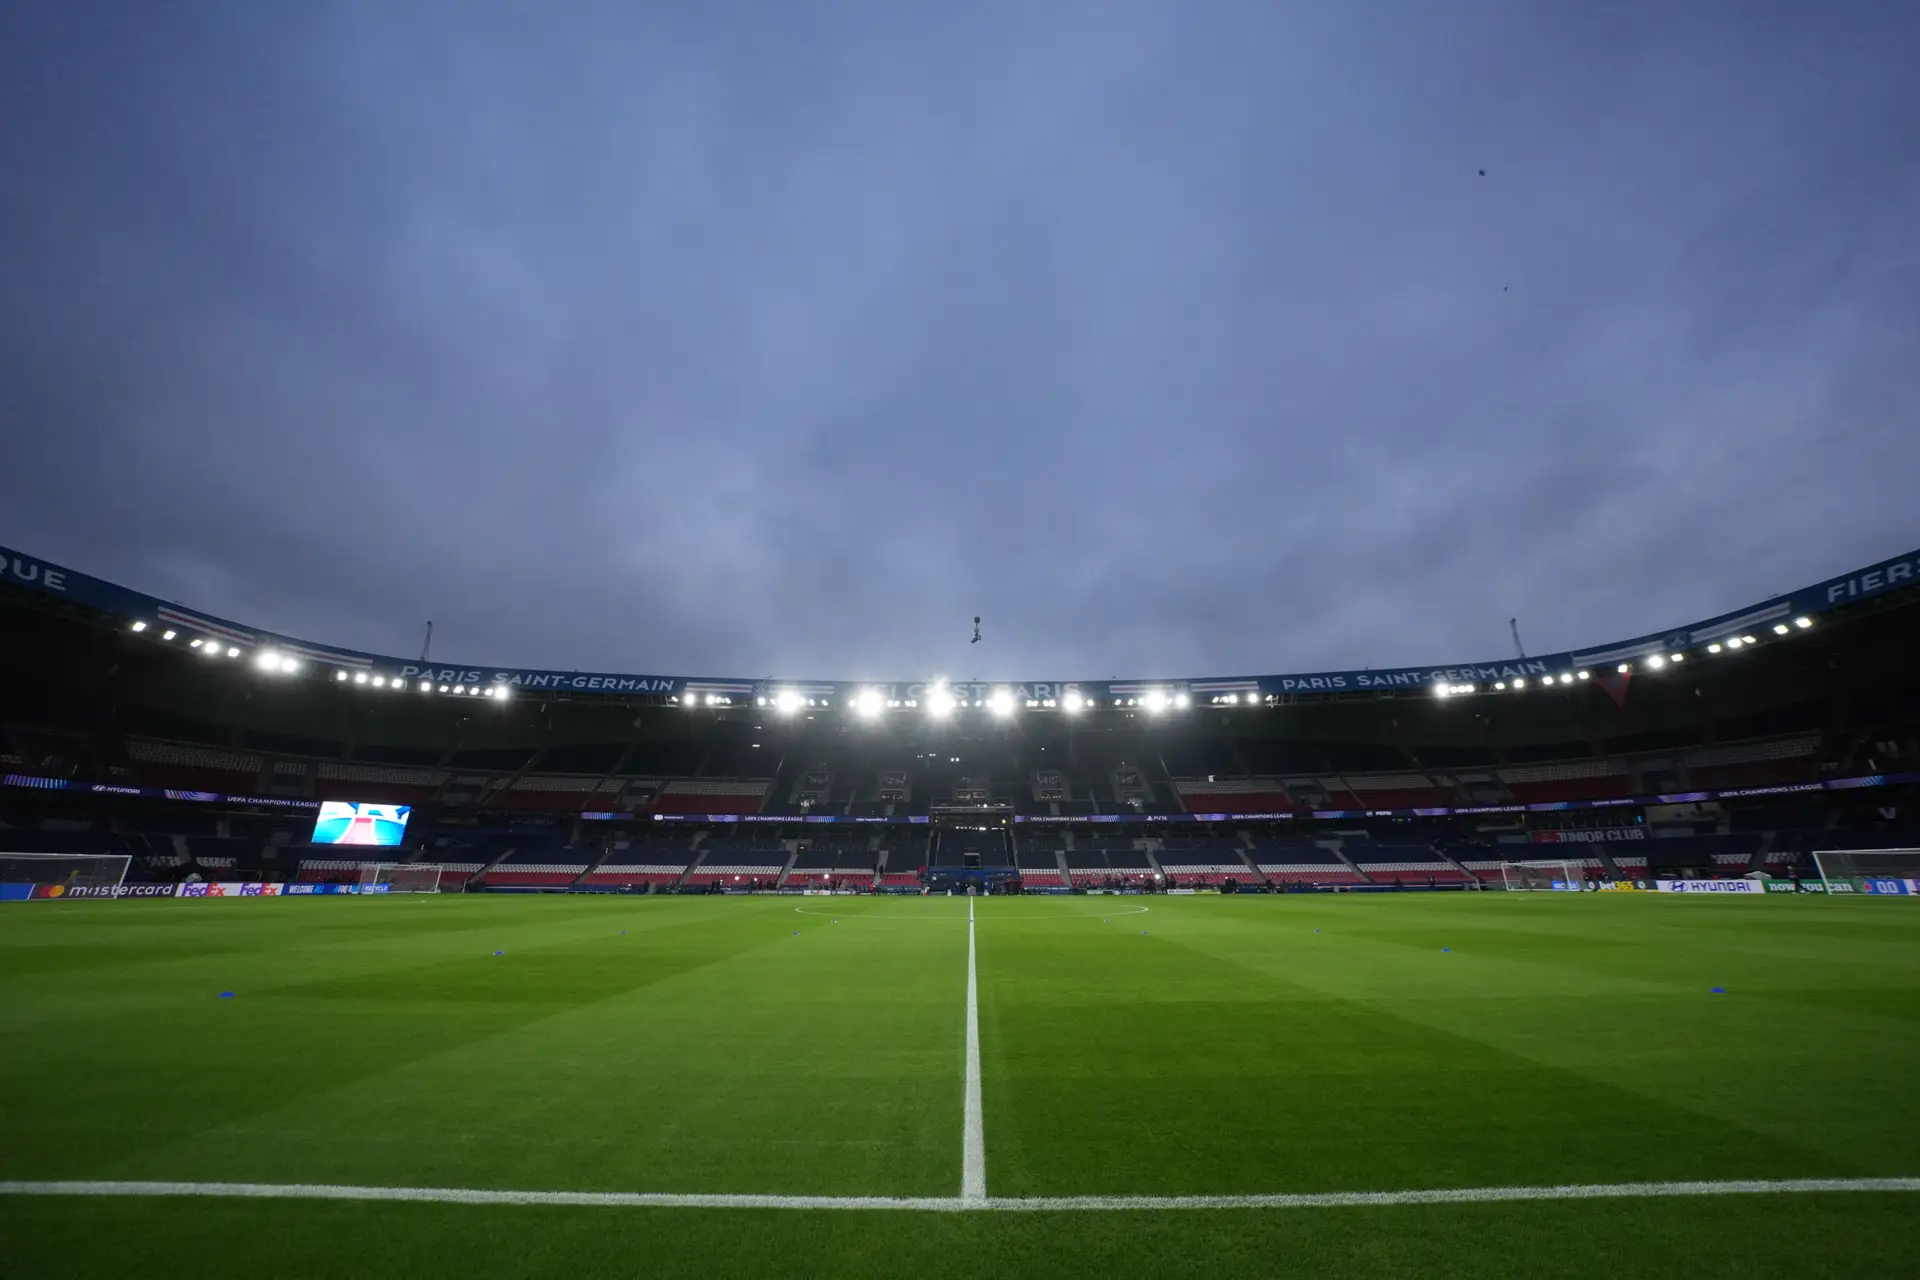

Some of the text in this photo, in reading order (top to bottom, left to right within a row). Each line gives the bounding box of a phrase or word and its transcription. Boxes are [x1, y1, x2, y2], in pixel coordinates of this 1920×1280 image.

[1827, 557, 1920, 603] FIER
[400, 665, 675, 691] PARIS SAINT-GERMAIN
[1282, 660, 1547, 690] PARIS SAINT-GERMAIN
[1740, 787, 1789, 796] CHAMPIONS
[1789, 783, 1823, 791] LEAGUE
[247, 797, 291, 806] CHAMPIONS
[1607, 828, 1645, 841] CLUB
[68, 884, 173, 896] mastercard
[181, 883, 225, 896] FedEx
[240, 883, 278, 896] FedEx
[1599, 881, 1634, 891] bet365
[1691, 881, 1753, 892] HYUNDAI
[1768, 883, 1796, 891] now
[1829, 882, 1854, 891] can
